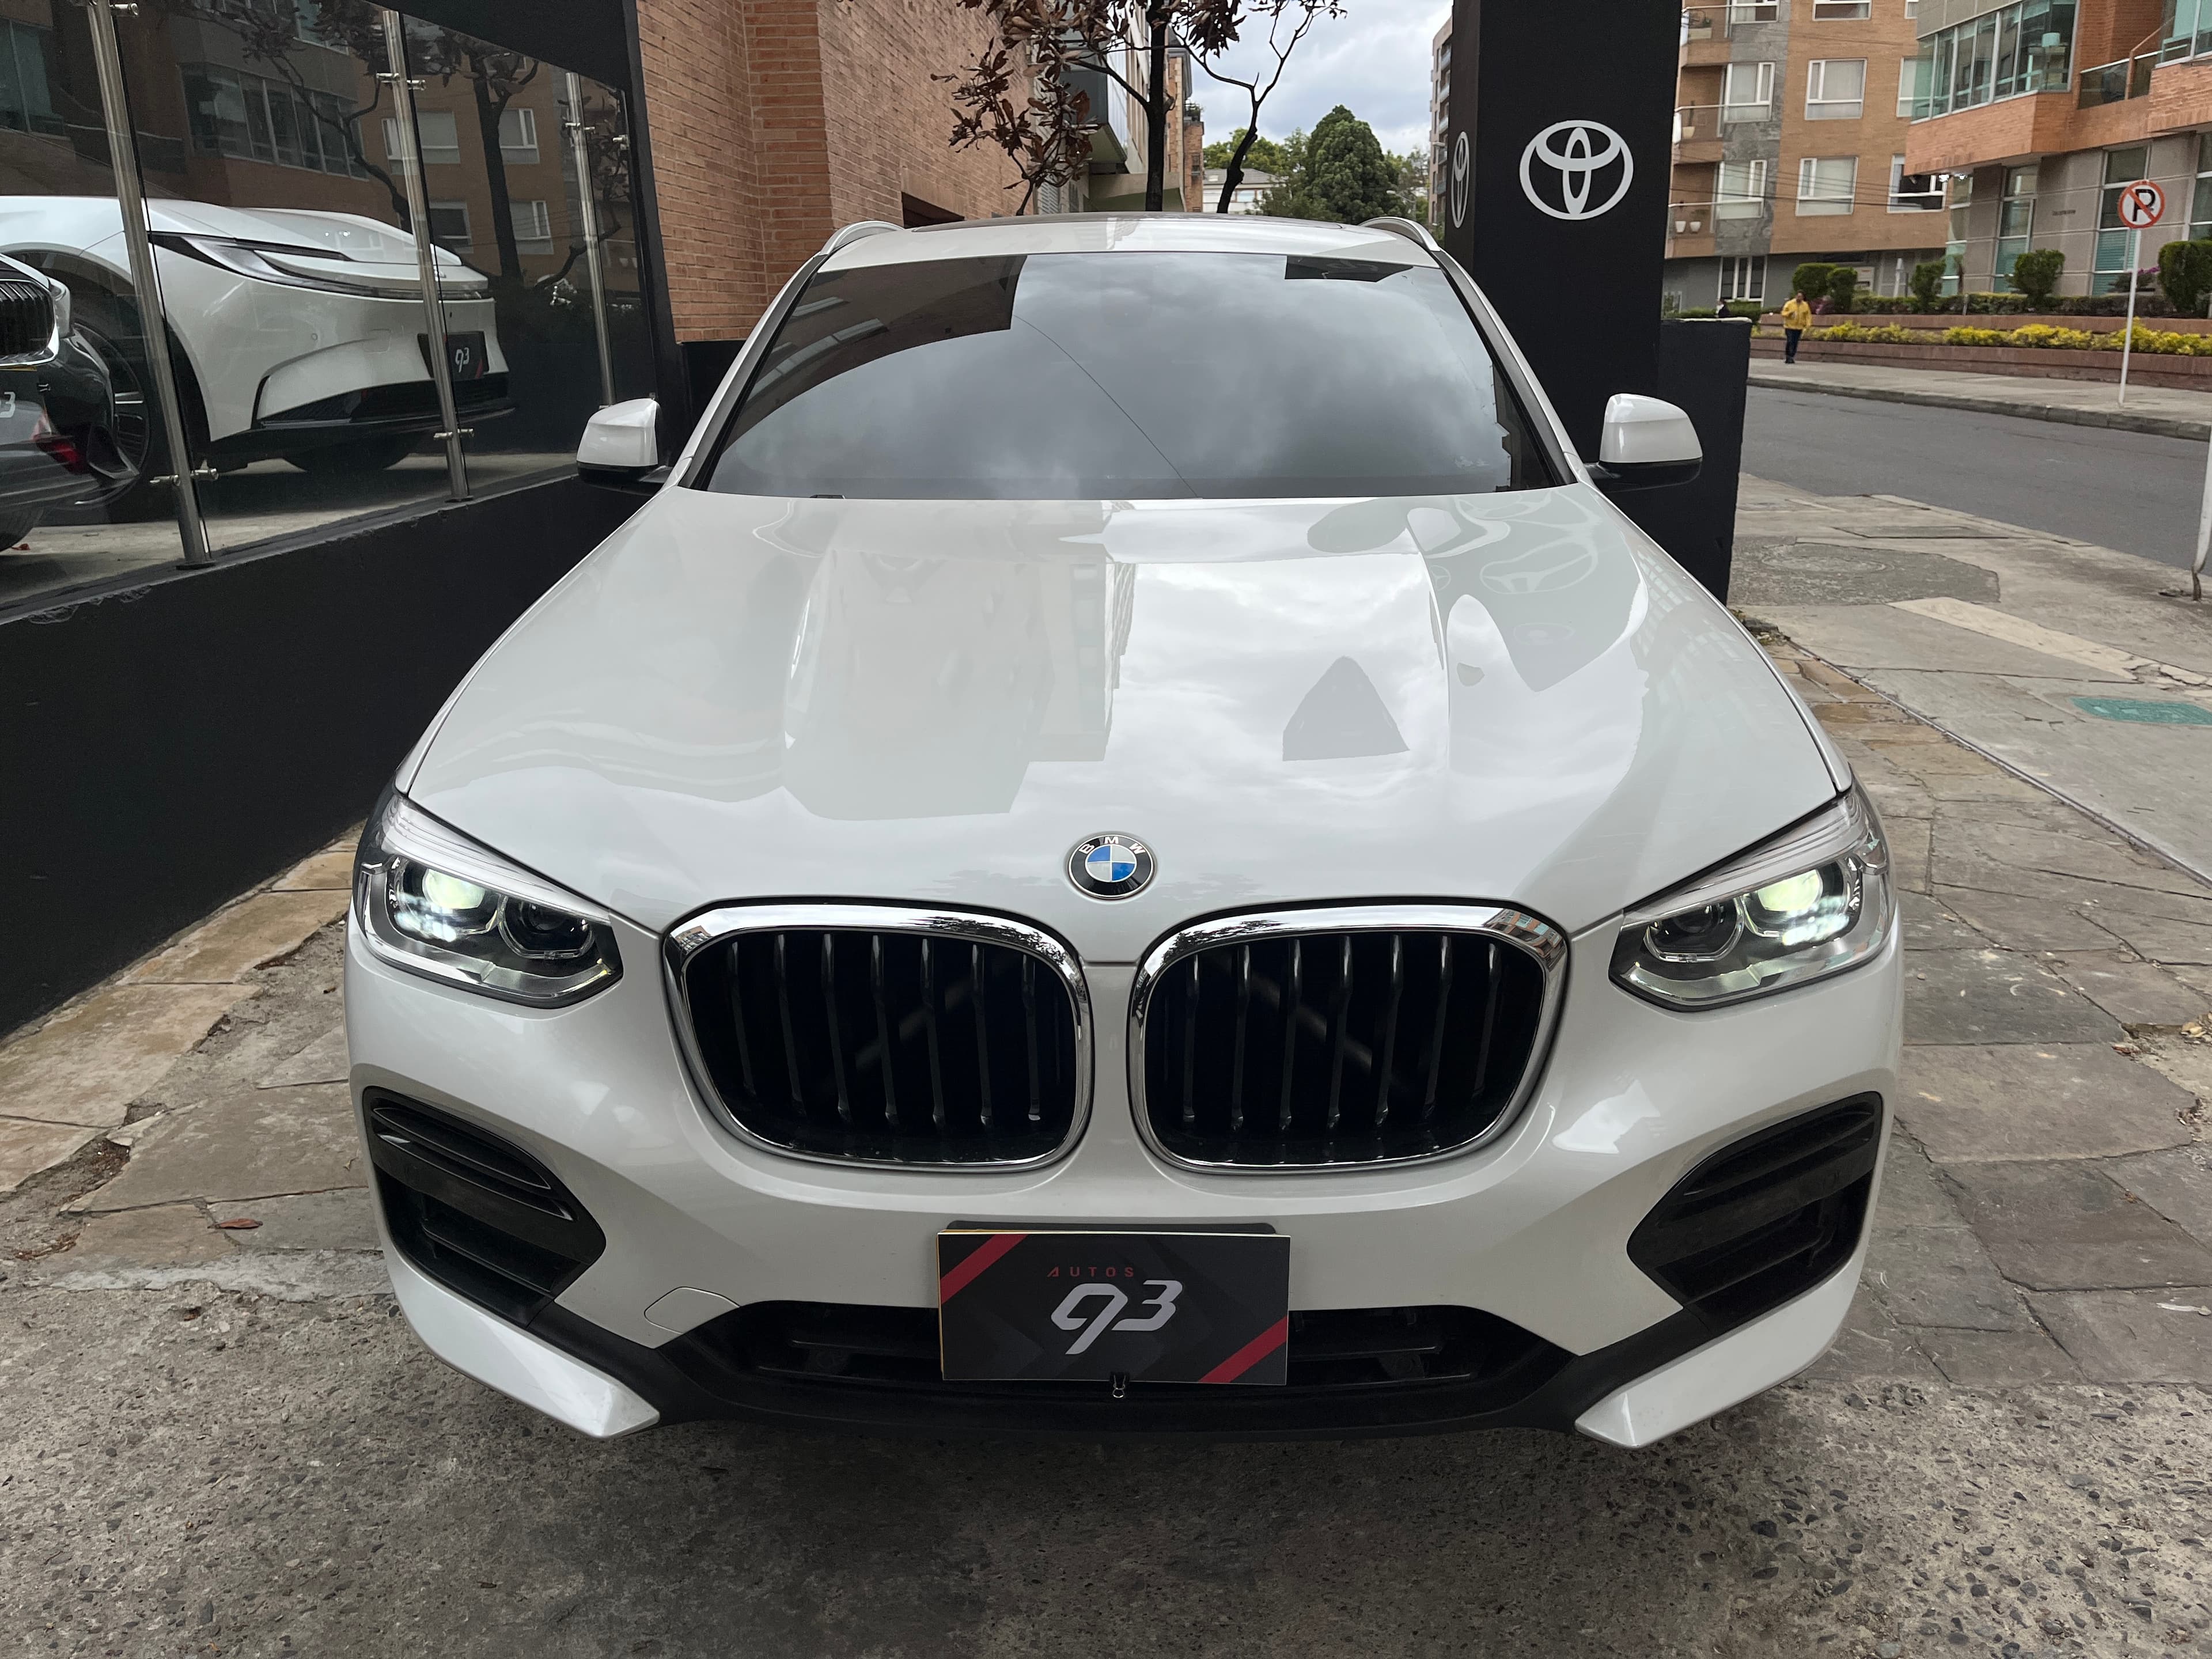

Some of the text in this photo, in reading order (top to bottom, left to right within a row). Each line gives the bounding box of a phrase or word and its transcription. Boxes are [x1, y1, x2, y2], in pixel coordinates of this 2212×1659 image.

[2133, 188, 2156, 222] P
[455, 347, 469, 373] 93
[0, 391, 16, 418] 3
[1078, 836, 1146, 855] BMW
[1047, 1266, 1134, 1278] AUTOS
[1050, 1279, 1183, 1355] 93
